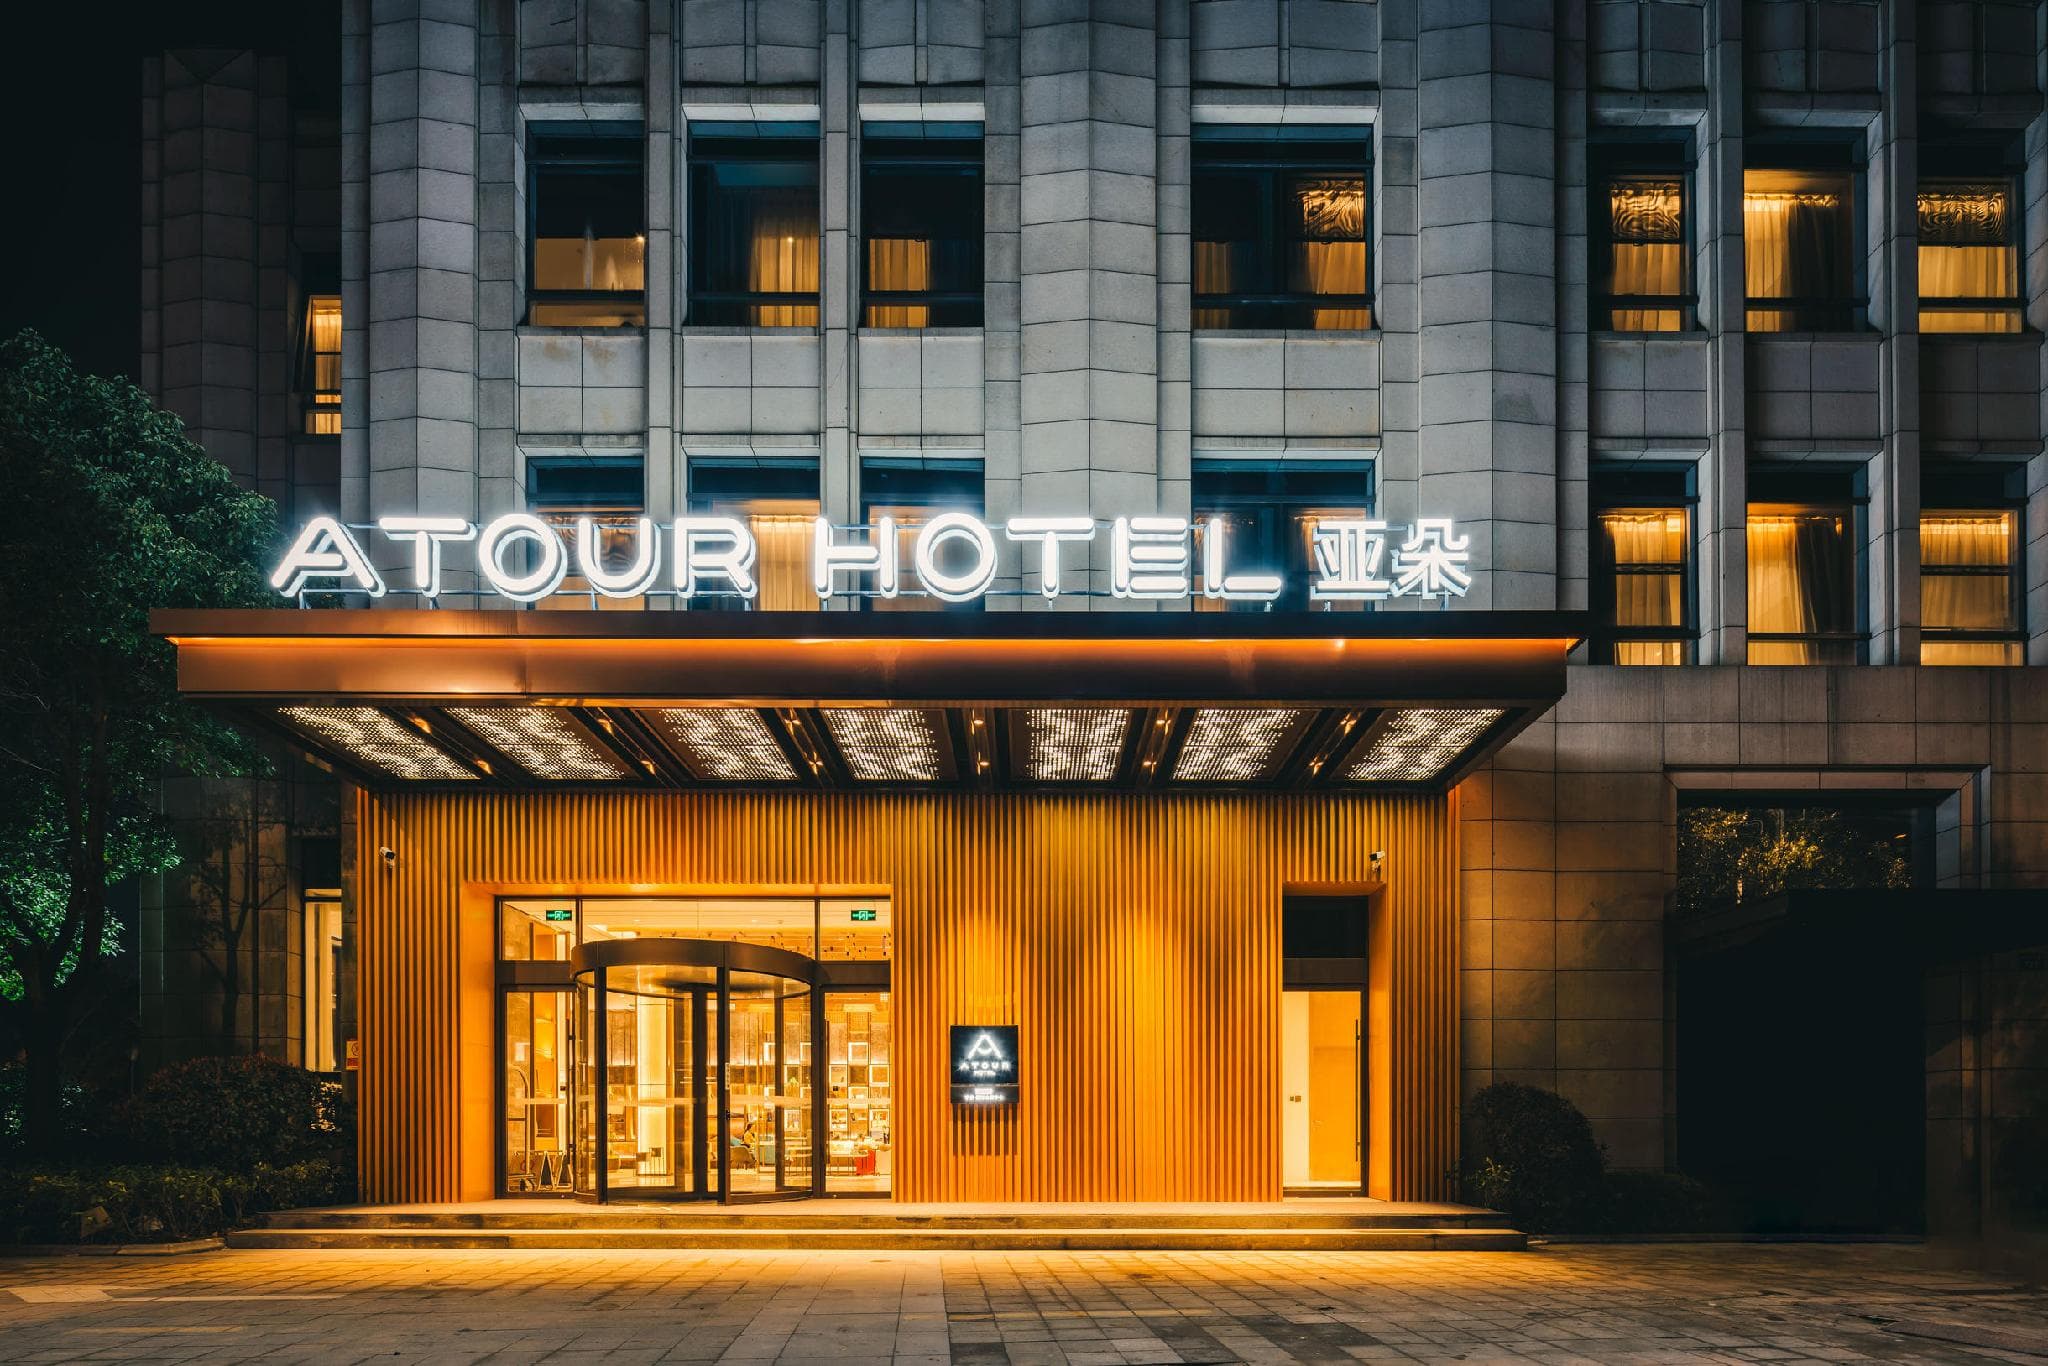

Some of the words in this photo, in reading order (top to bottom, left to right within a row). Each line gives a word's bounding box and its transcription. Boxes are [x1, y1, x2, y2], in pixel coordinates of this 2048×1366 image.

[270, 512, 758, 601] ATOUR
[814, 512, 1281, 601] HOTEL
[1309, 517, 1473, 598] 亚朵
[959, 1061, 1011, 1072] ATOUR
